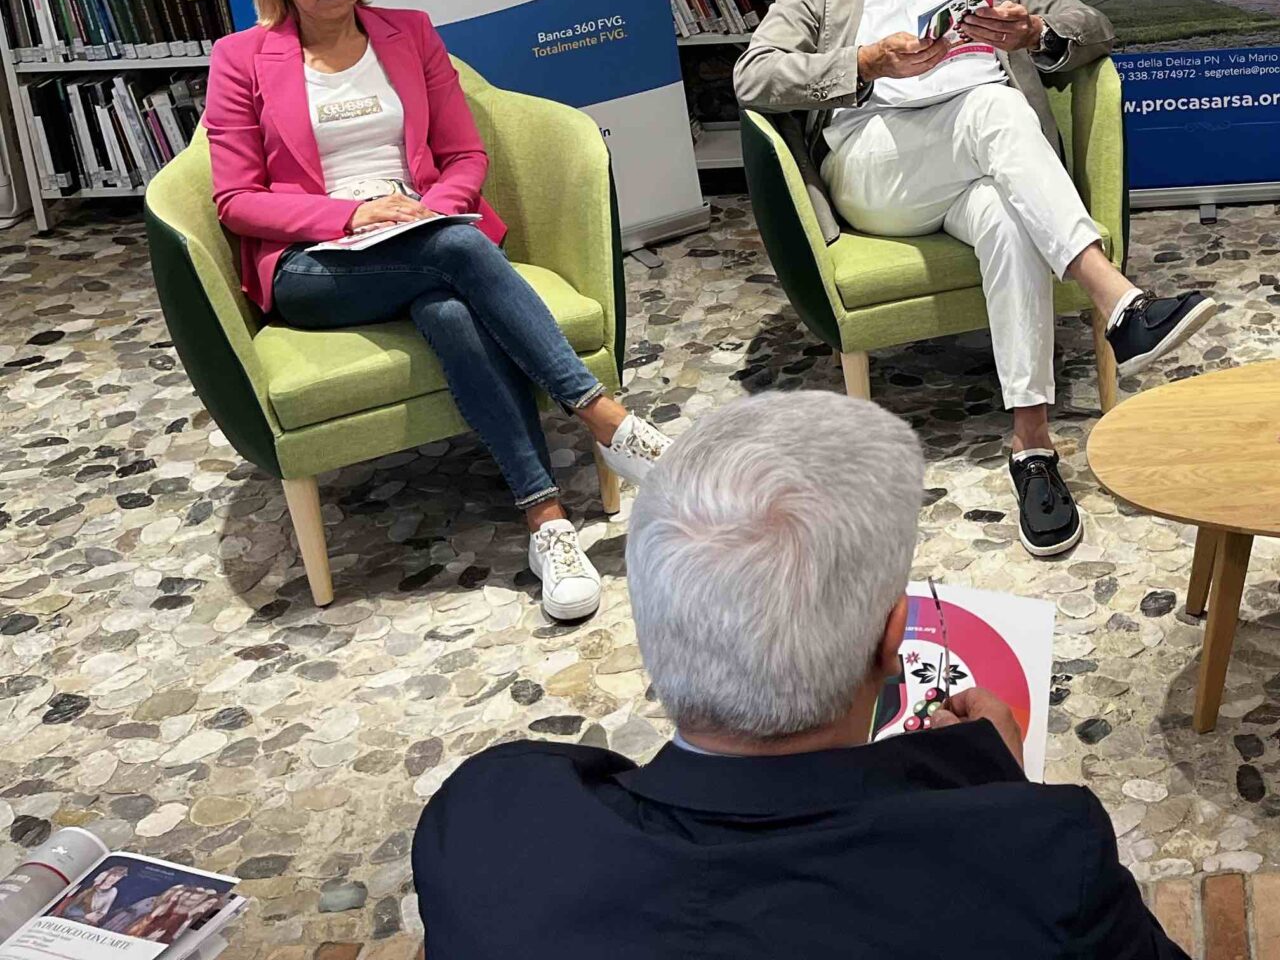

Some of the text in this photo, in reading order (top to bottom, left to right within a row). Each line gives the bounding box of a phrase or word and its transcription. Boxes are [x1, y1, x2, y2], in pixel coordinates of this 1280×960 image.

[537, 16, 626, 44] Banca 360 FVG.
[532, 28, 628, 59] Totalmente FVG.
[1114, 60, 1134, 69] arsa
[1137, 58, 1162, 68] della
[1166, 56, 1201, 67] Delizia
[1204, 56, 1220, 64] PN
[1228, 54, 1246, 64] Via
[1248, 52, 1278, 62] Mario
[1127, 70, 1196, 81] 338.7874972
